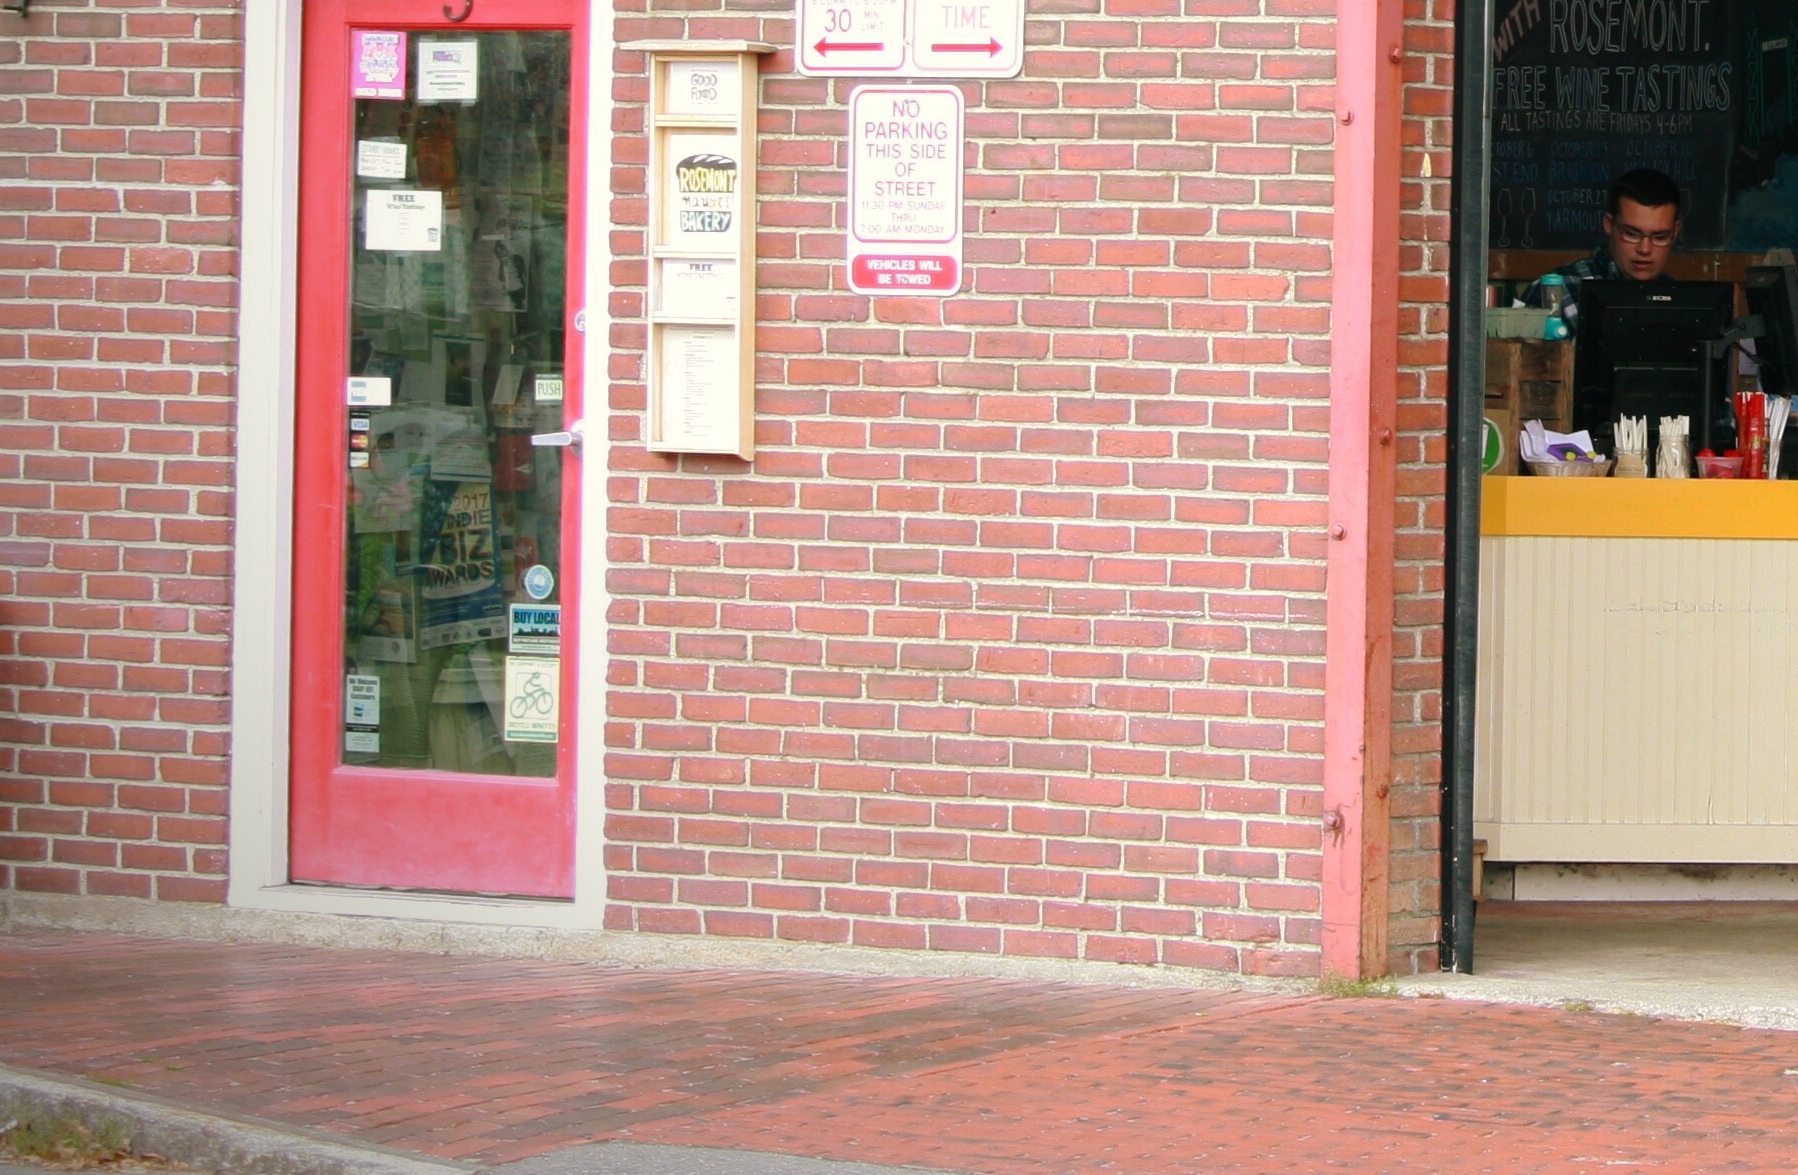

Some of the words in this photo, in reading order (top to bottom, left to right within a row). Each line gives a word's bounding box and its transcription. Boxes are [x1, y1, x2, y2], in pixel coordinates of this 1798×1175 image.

[824, 8, 852, 33] 30
[864, 10, 880, 20] MIN
[941, 5, 991, 29] TIME
[860, 22, 884, 32] LIMIT
[1493, 65, 1547, 110] FREE
[1555, 66, 1610, 112] WINE
[1616, 61, 1733, 113] TASTINGS
[892, 99, 920, 118] NO
[1501, 113, 1521, 132] ALL
[1526, 110, 1581, 131] TASTINGS
[1585, 112, 1606, 131] ARE
[1610, 112, 1651, 133] FRIDAYS
[864, 121, 948, 140] PARKING
[866, 143, 901, 159] THIS
[910, 143, 946, 159] SIDE
[1493, 141, 1524, 158] TOBER
[895, 162, 917, 178] OF
[679, 167, 736, 192] ROSEMONT
[874, 181, 936, 197] STREET
[1547, 188, 1592, 204] OCTOBER
[392, 194, 415, 203] FREE
[888, 200, 903, 210] PM
[907, 200, 945, 211] SUNDAY
[891, 213, 916, 223] THRU
[1547, 210, 1607, 234] YARMOUT
[905, 225, 945, 235] MONDAY
[689, 263, 713, 272] FREE
[867, 259, 915, 271] VEHICLES
[918, 260, 943, 272] WILL
[878, 273, 892, 284] BE
[896, 274, 932, 285] TOWED
[537, 382, 562, 397] PUSH
[454, 493, 489, 511] 2017
[447, 509, 490, 528] INDIE
[440, 528, 491, 566] BIZ
[426, 561, 494, 589] AWARDS
[514, 611, 532, 624] BUY
